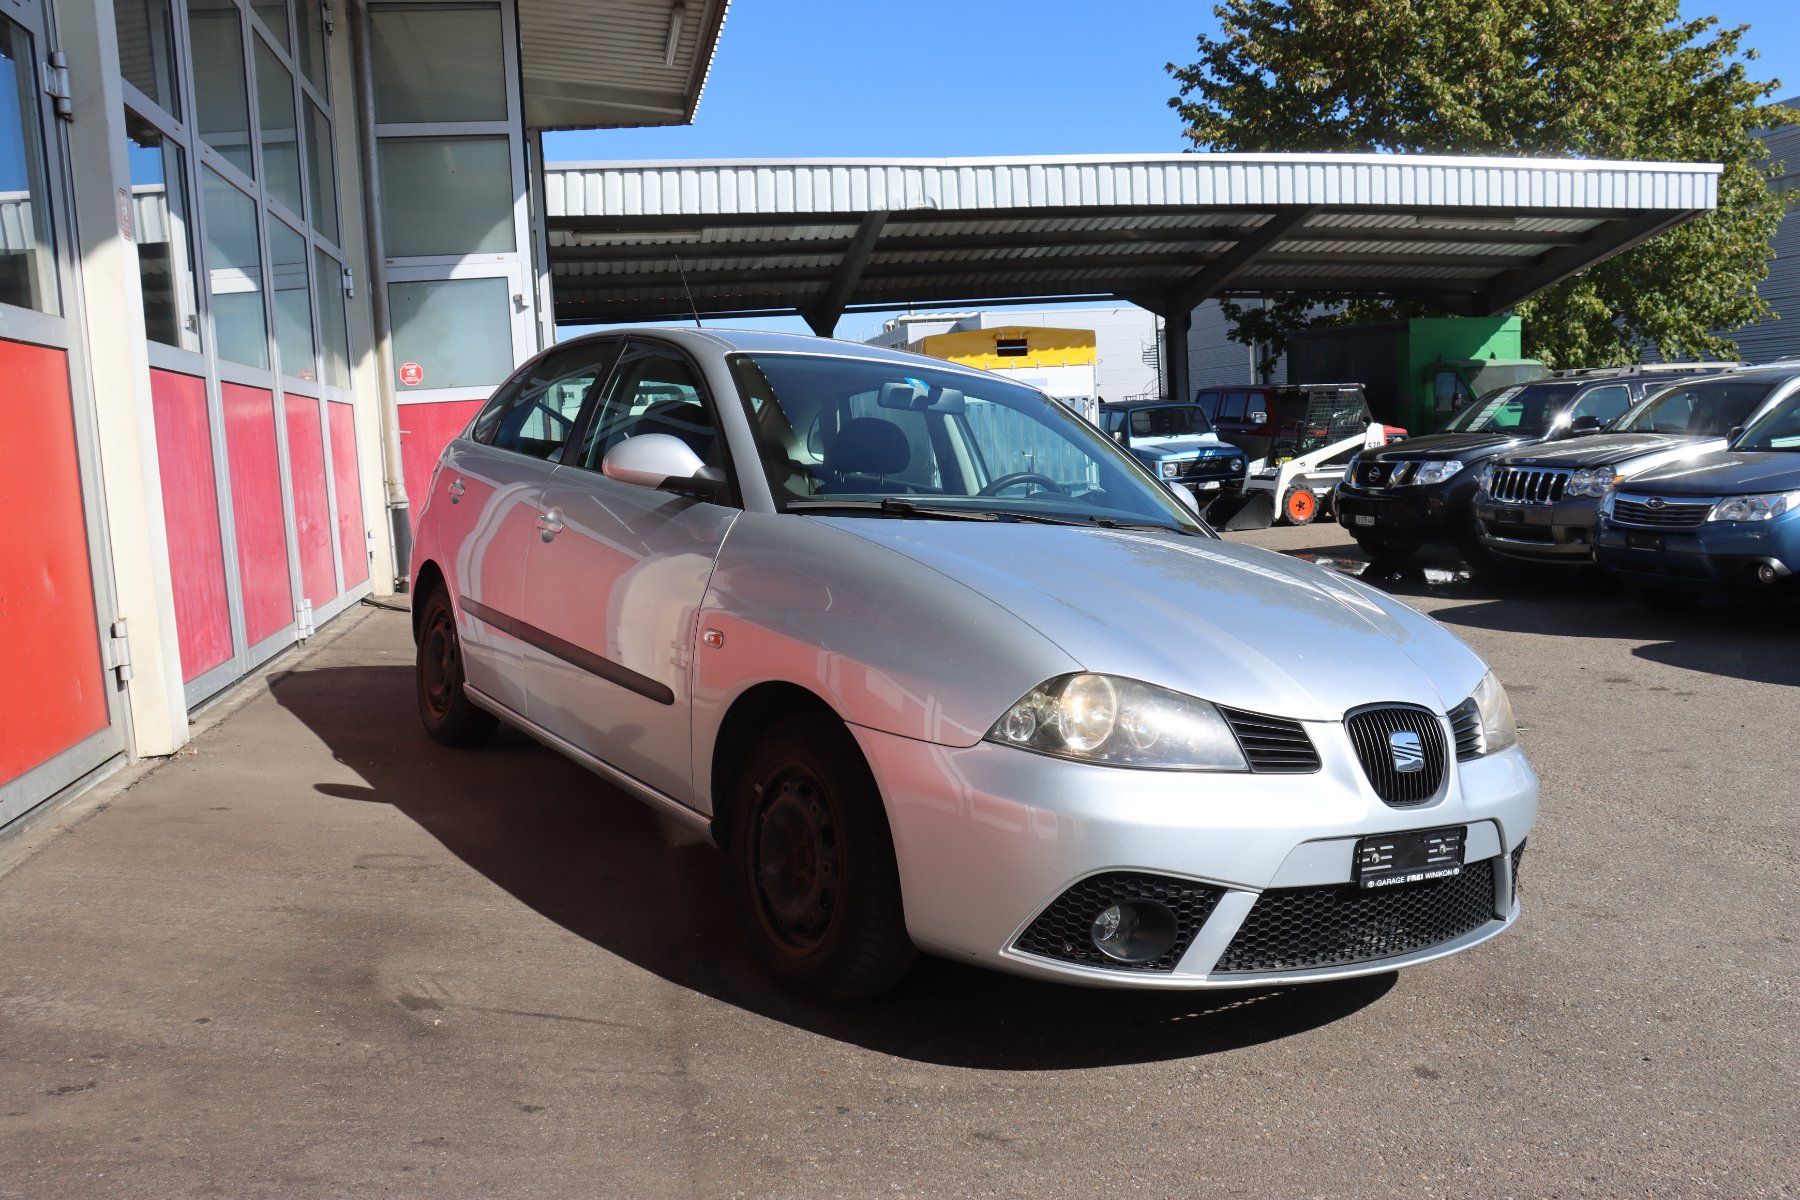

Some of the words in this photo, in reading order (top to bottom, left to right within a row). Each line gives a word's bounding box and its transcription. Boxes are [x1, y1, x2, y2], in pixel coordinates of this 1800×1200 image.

[1376, 876, 1405, 887] GARAGE
[1406, 873, 1424, 882] FREI
[1425, 869, 1453, 880] WINIKON
